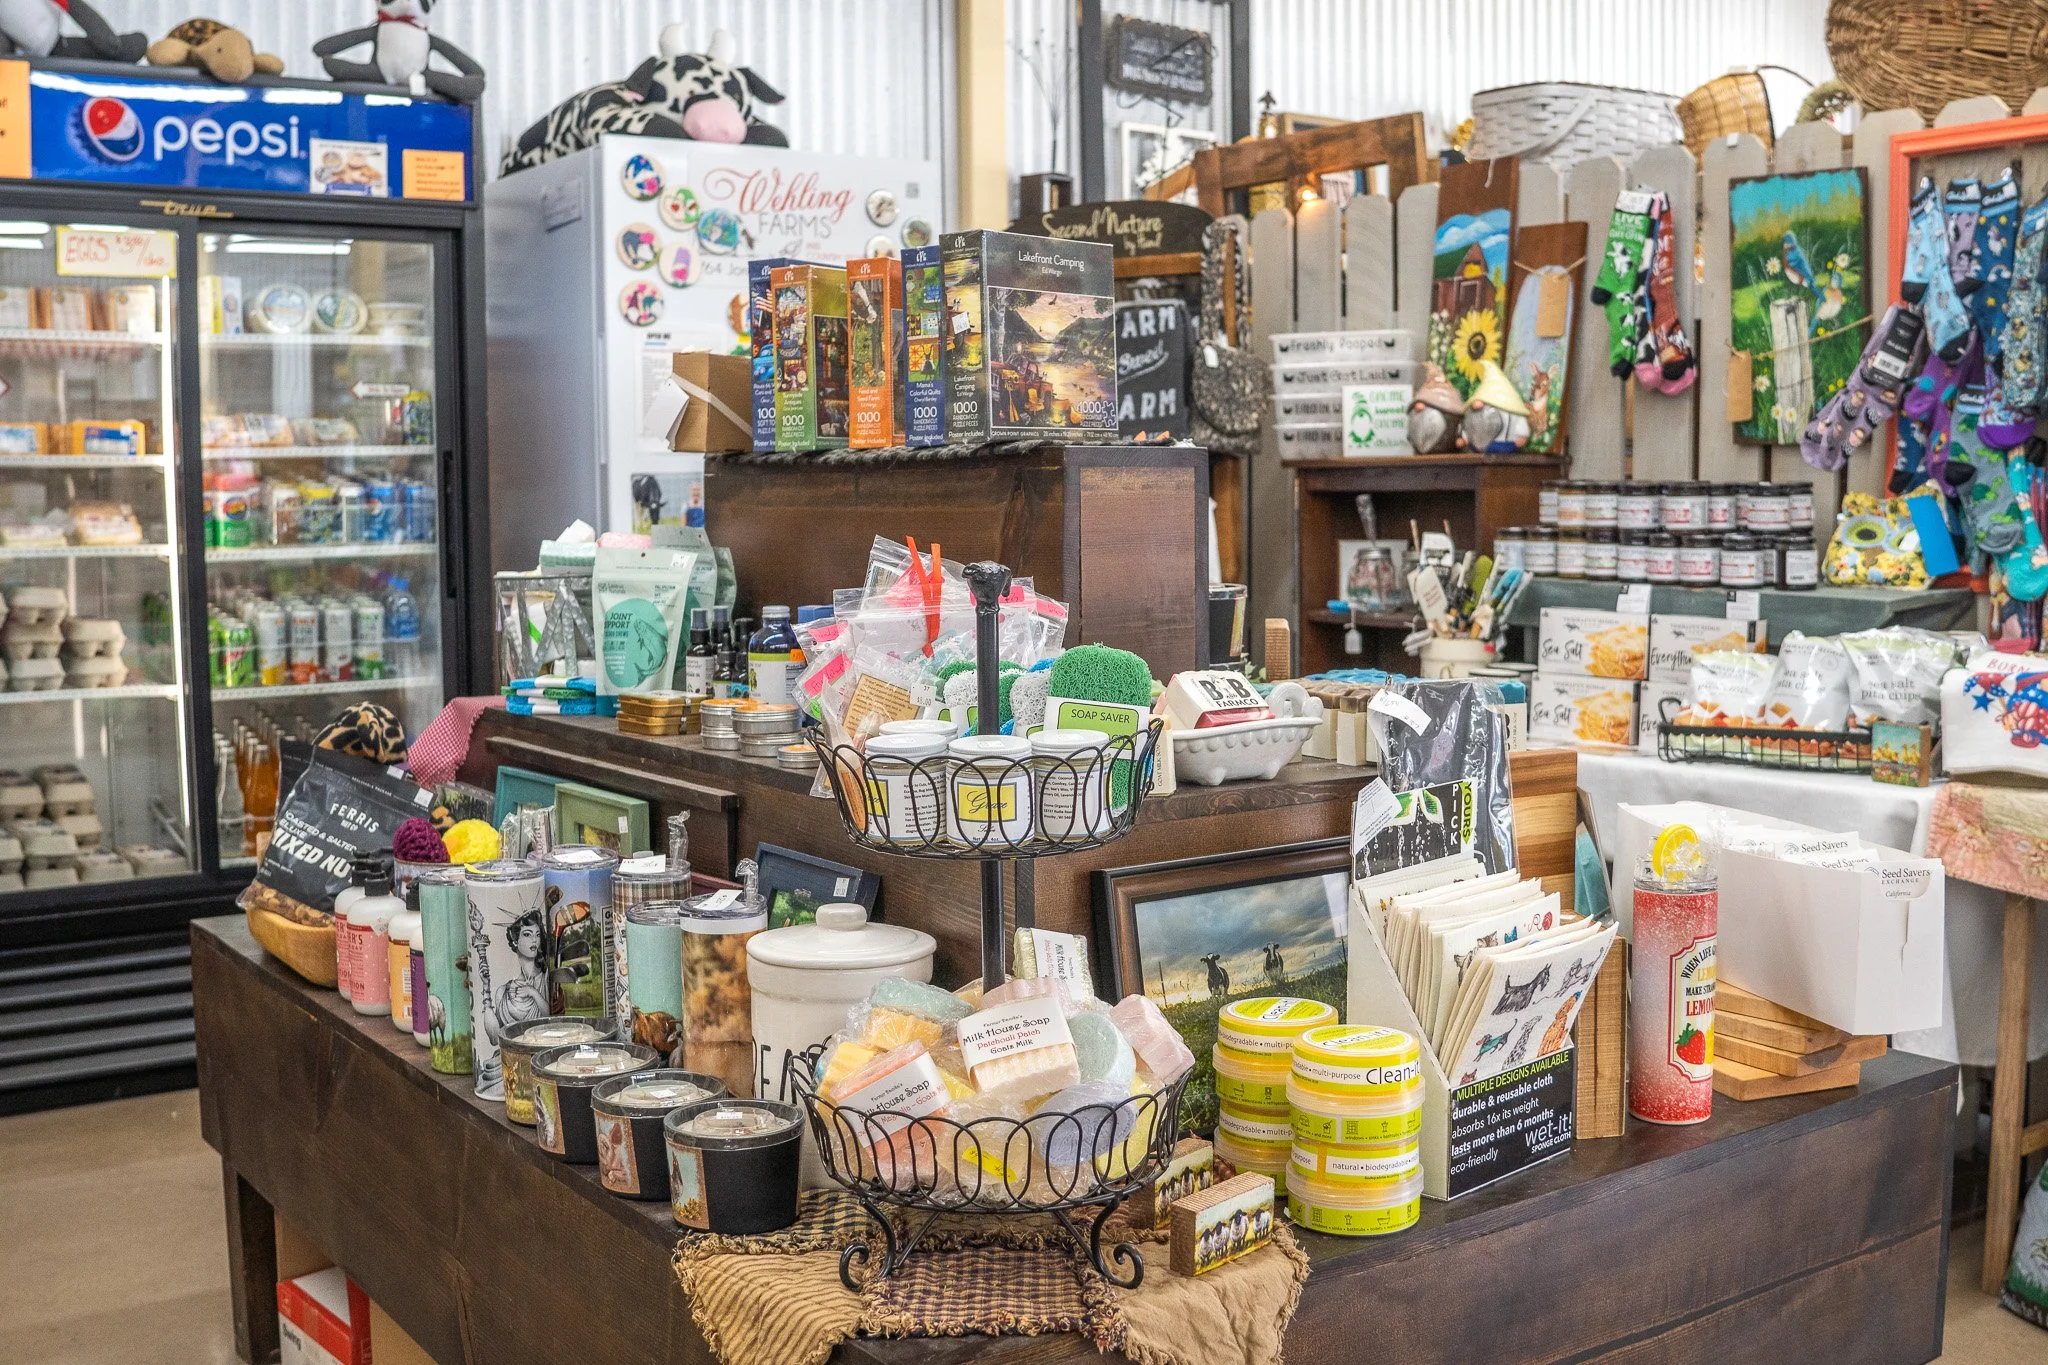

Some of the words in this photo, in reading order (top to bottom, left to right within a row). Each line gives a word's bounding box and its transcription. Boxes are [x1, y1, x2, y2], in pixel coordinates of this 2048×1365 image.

[153, 115, 299, 164] pepsi
[703, 168, 853, 223] Wehling
[758, 213, 832, 238] FARMS
[1041, 207, 1101, 239] Second
[1100, 206, 1164, 235] Nature
[1018, 250, 1052, 264] Lakefront
[1053, 254, 1085, 272] Camping
[1119, 306, 1177, 339] ARM
[758, 408, 777, 419] 100
[914, 406, 938, 418] 1000
[953, 401, 978, 414] 1000
[1077, 401, 1101, 413] 1000
[1118, 388, 1176, 421] ARM
[782, 415, 805, 426] 1000
[857, 411, 881, 423] 1000
[605, 621, 630, 629] PPORT
[1541, 638, 1559, 658] Sea
[1564, 639, 1583, 660] Salt
[1198, 680, 1224, 701] B
[1226, 678, 1251, 699] B
[1216, 698, 1259, 708] FARMCO
[1532, 702, 1549, 722] Sea
[1553, 704, 1573, 726] Salt
[1071, 708, 1098, 720] SOAP
[1099, 712, 1130, 723] SAVER
[329, 803, 380, 833] FERRIS
[1463, 783, 1473, 838] YOURS
[279, 819, 308, 840] ELUXE
[319, 832, 327, 840] &
[1801, 841, 1820, 853] Seed
[1821, 839, 1849, 851] Savers
[1881, 868, 1902, 879] Seed
[1903, 866, 1931, 878] Savers
[1881, 877, 1919, 885] EXCHANGE
[1885, 890, 1911, 898] California
[1681, 955, 1701, 978] WHEN
[1699, 946, 1712, 961] LIFE
[1685, 985, 1702, 996] MAKE
[963, 1032, 984, 1046] Milk
[985, 1022, 1021, 1037] House
[1022, 1016, 1050, 1027] Soap
[976, 1035, 1016, 1050] Patchouli
[1018, 1028, 1041, 1039] Patch
[990, 1045, 1015, 1054] Goats
[1016, 1039, 1034, 1048] Milk
[1312, 1068, 1361, 1081] multi-purpose
[1456, 1081, 1494, 1101] MULTIPLE
[1495, 1066, 1530, 1087] DESIGNS
[1530, 1050, 1569, 1075] AVAILABLE
[876, 1093, 906, 1111] House
[904, 1079, 930, 1097] Soap
[1452, 1099, 1485, 1120] durable
[1488, 1095, 1495, 1107] &
[1496, 1082, 1532, 1104] reusable
[1533, 1073, 1553, 1090] cloth
[881, 1107, 911, 1124] Maglia
[915, 1091, 937, 1105] Goats
[1452, 1119, 1485, 1139] absorbs
[1487, 1113, 1500, 1125] 16x
[1502, 1107, 1511, 1120] its
[1512, 1097, 1539, 1116] weight
[1451, 1141, 1471, 1157] lasts
[1472, 1133, 1495, 1148] more
[1496, 1124, 1515, 1139] than
[1516, 1119, 1523, 1131] 6
[1524, 1108, 1554, 1127] months
[1525, 1112, 1573, 1147] wet-it!
[1531, 1139, 1554, 1153] SPONGE
[1553, 1131, 1571, 1145] CLOTH
[1332, 1162, 1360, 1171] natural
[1365, 1159, 1409, 1171] biodegradable
[1450, 1147, 1499, 1175] eco-friendly
